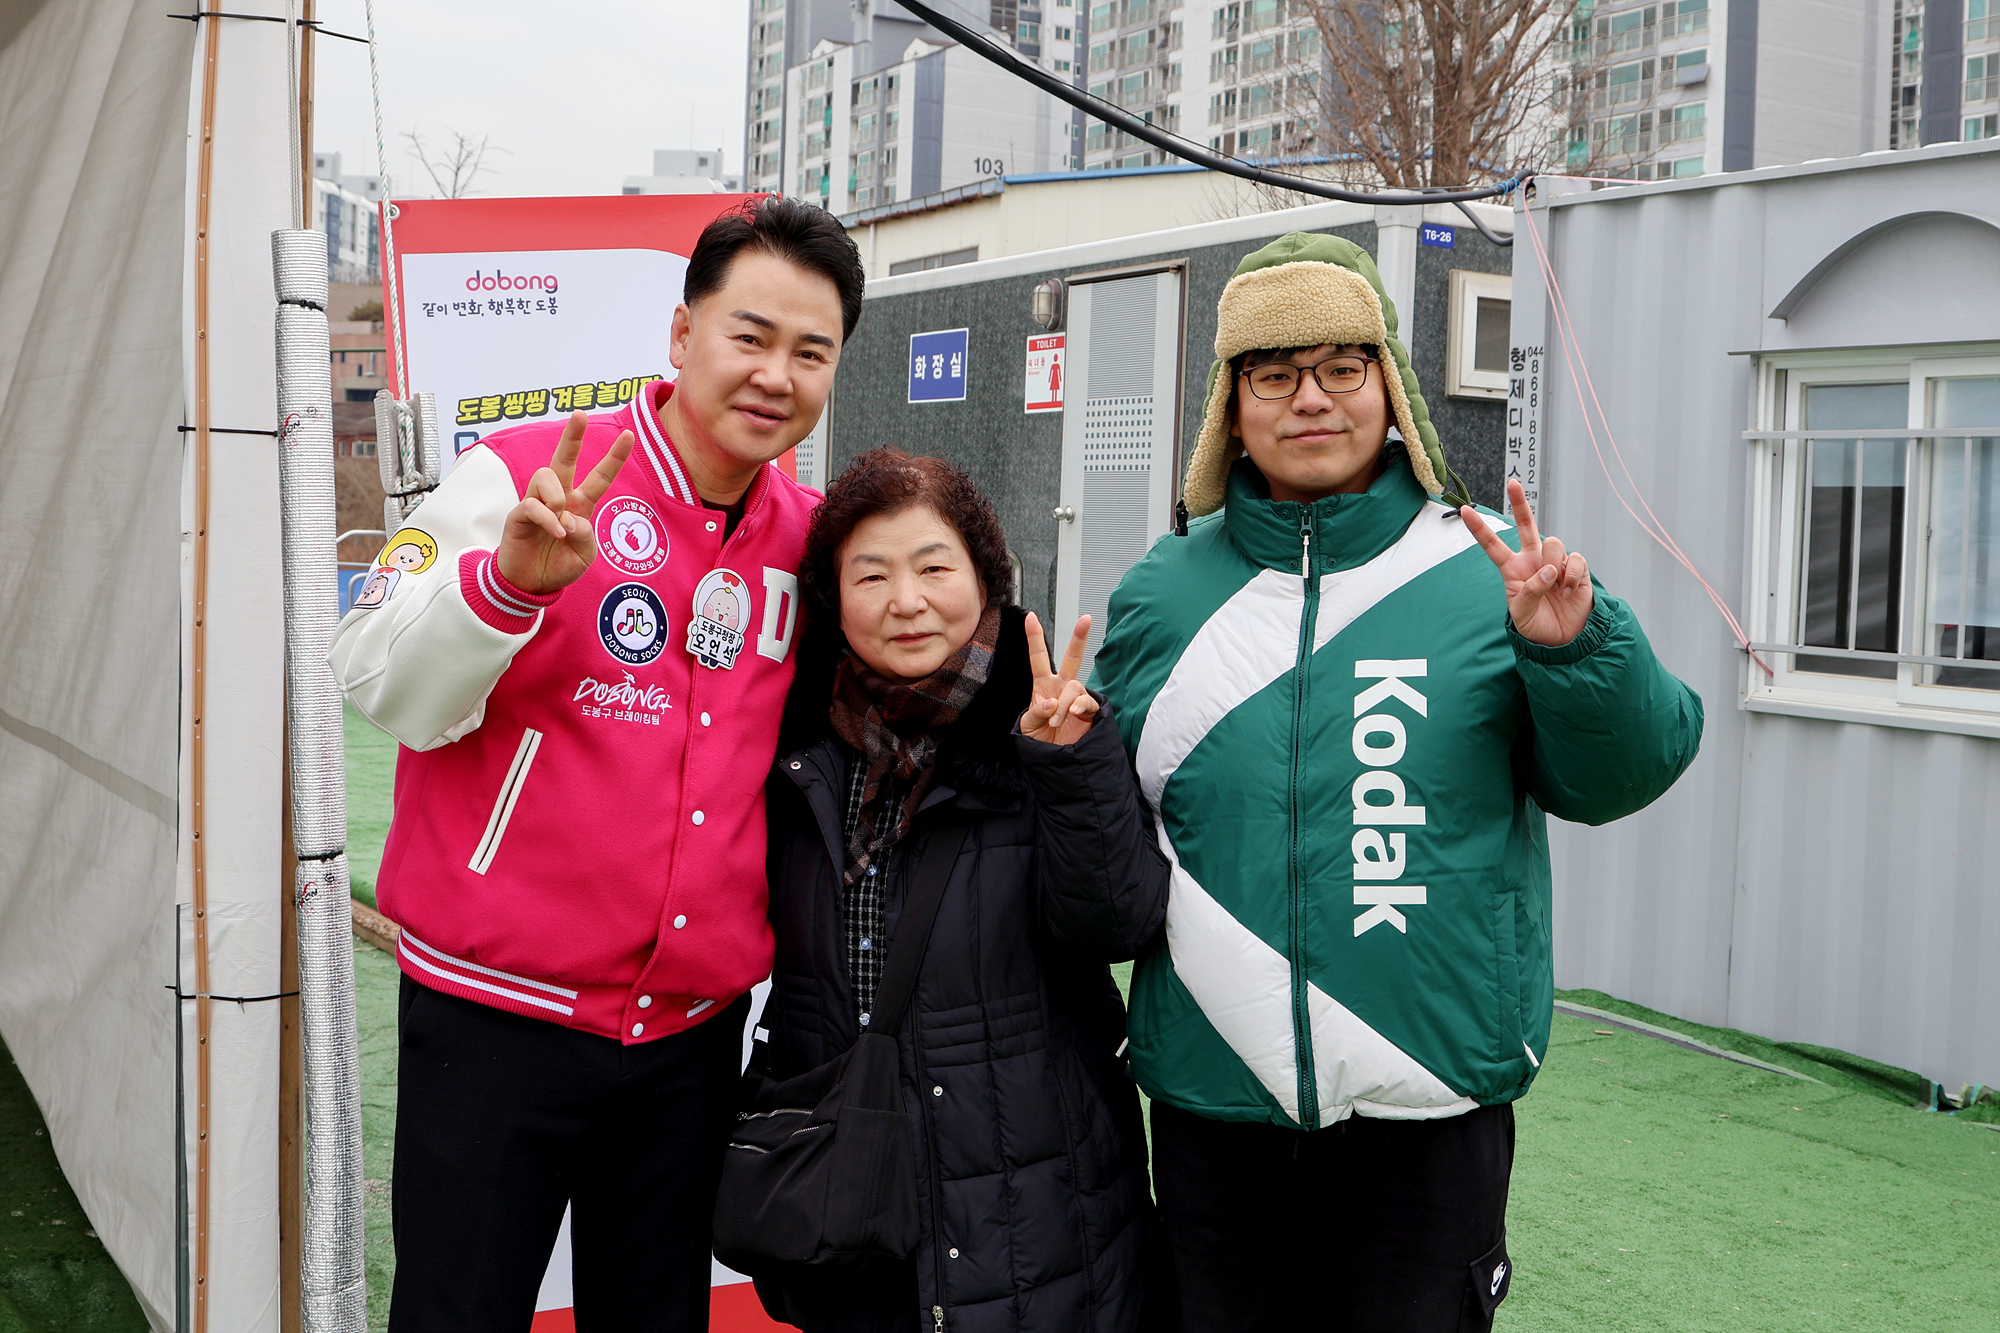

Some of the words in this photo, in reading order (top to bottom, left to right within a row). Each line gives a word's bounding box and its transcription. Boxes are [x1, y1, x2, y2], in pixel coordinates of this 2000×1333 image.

[974, 157, 1003, 176] 103
[1424, 229, 1452, 243] T6-26
[465, 269, 558, 294] dobong
[422, 302, 448, 318] 같이
[452, 298, 485, 317] 변화,
[487, 297, 532, 316] 행복한
[535, 296, 559, 315] 도봉
[1036, 338, 1058, 349] TOILET
[1527, 346, 1544, 358] 044
[914, 351, 962, 380] 화장실
[621, 588, 650, 602] SEOUL
[757, 566, 799, 664] D
[700, 620, 736, 644] 도봉구청장
[604, 633, 638, 661] DOBONG
[640, 639, 662, 661] SOCKS
[693, 633, 735, 665] 오언석
[573, 676, 666, 711] DOBONG
[581, 704, 612, 719] 도봉구
[613, 709, 660, 725] 브레이킹팀
[1352, 658, 1428, 938] Kodak
